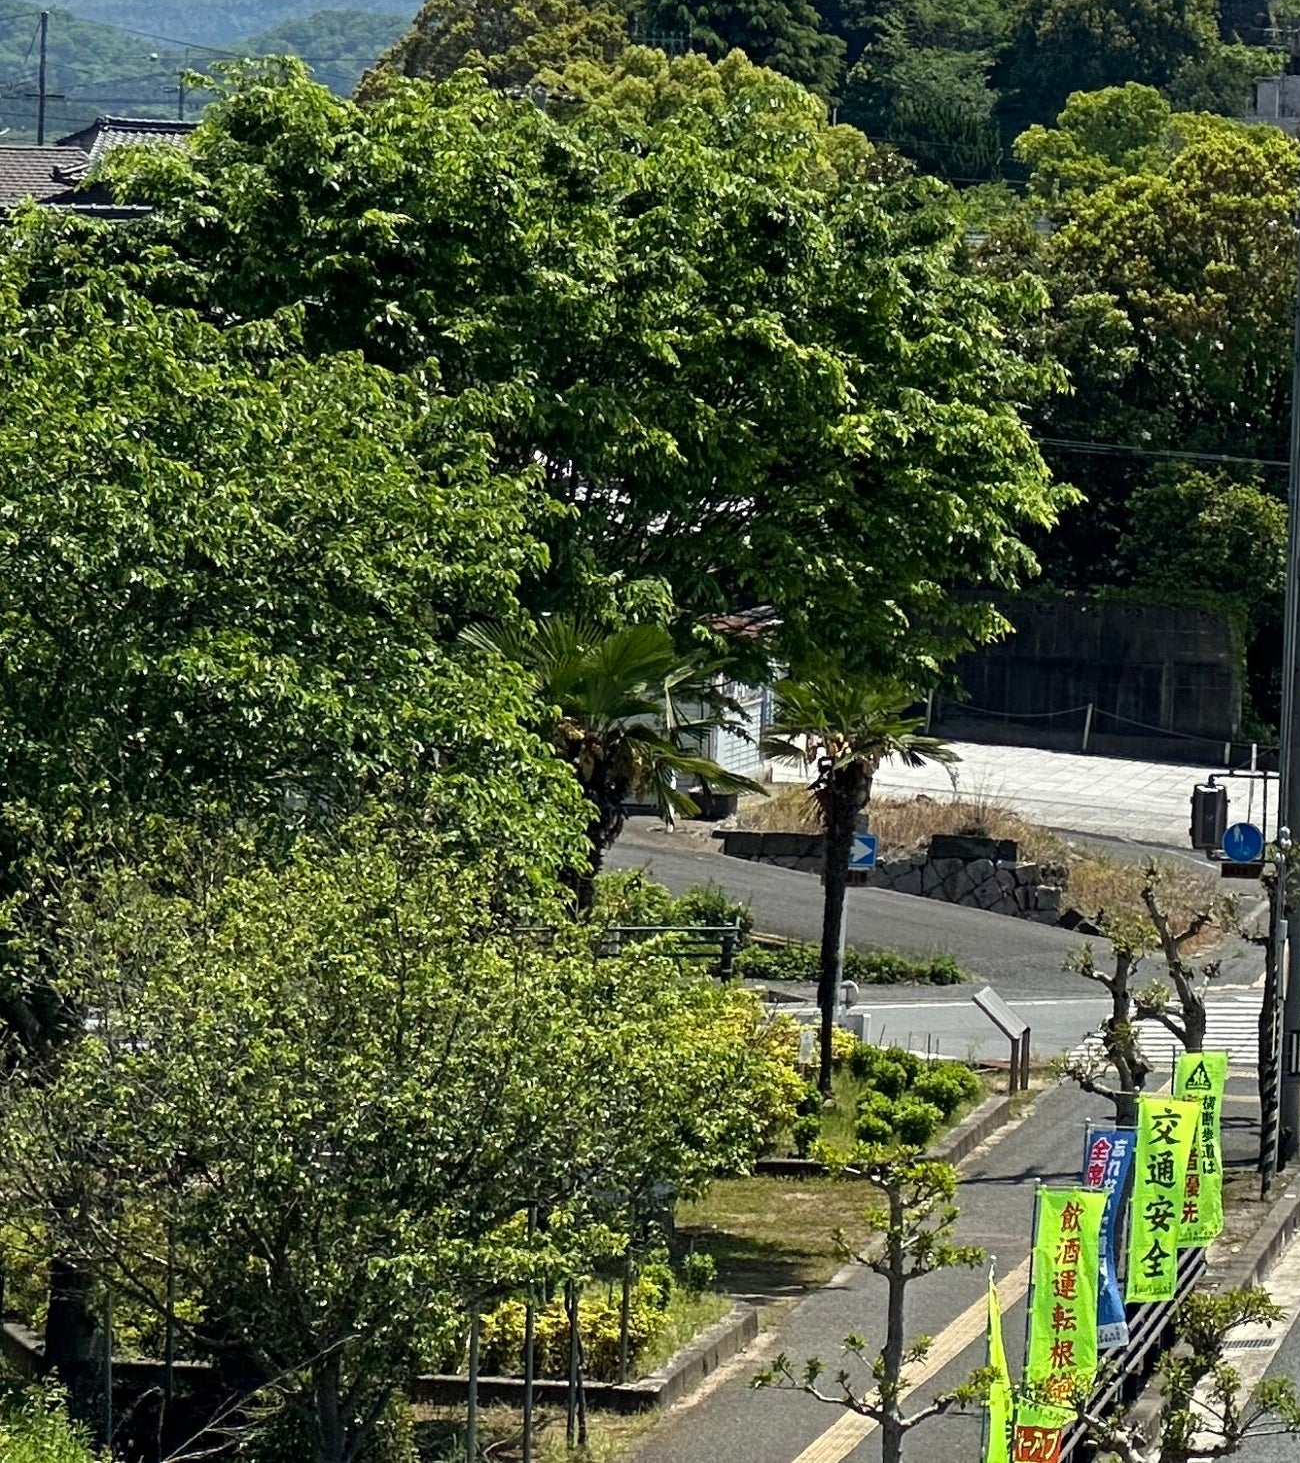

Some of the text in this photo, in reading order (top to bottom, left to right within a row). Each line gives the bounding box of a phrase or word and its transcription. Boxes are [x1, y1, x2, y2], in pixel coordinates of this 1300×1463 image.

[1140, 1106, 1182, 1278] 交通安全
[1201, 1094, 1217, 1175] 横断歩道は
